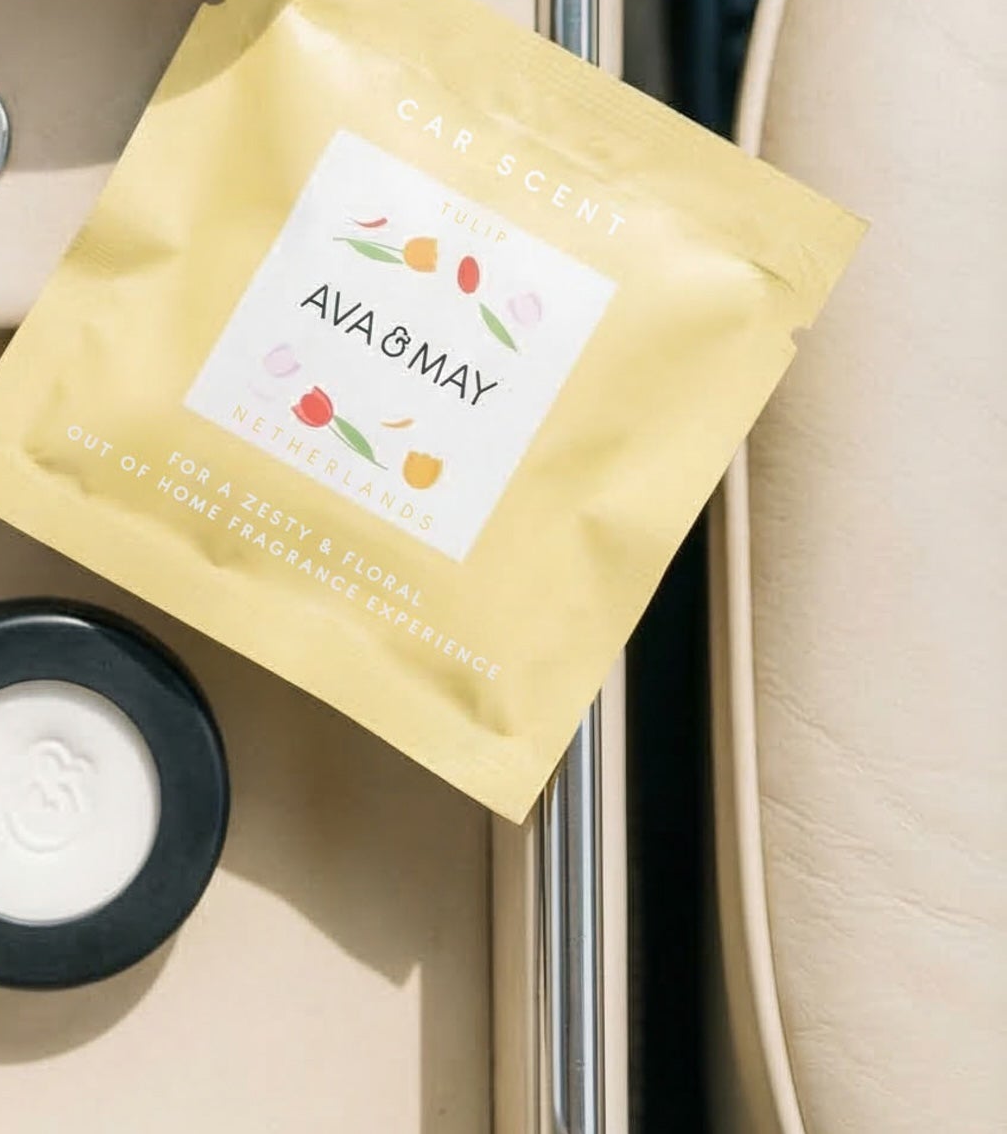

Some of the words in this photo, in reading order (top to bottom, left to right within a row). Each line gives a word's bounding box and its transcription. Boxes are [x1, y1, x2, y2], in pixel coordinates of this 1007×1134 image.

[396, 98, 474, 154] CAR
[495, 154, 627, 237] SCENT
[441, 201, 509, 244] TULIP
[167, 450, 211, 486] FOR
[216, 481, 233, 499] A
[240, 491, 313, 542] ZESTY
[318, 537, 333, 556] &
[341, 550, 424, 608] FLORAL
[230, 403, 435, 532] NETHERLANDS
[66, 424, 114, 458] OUT
[120, 454, 152, 479] OF
[156, 475, 223, 522] HOME
[226, 515, 361, 601] FRAGRANCE
[364, 594, 503, 682] EXPERIENCE
